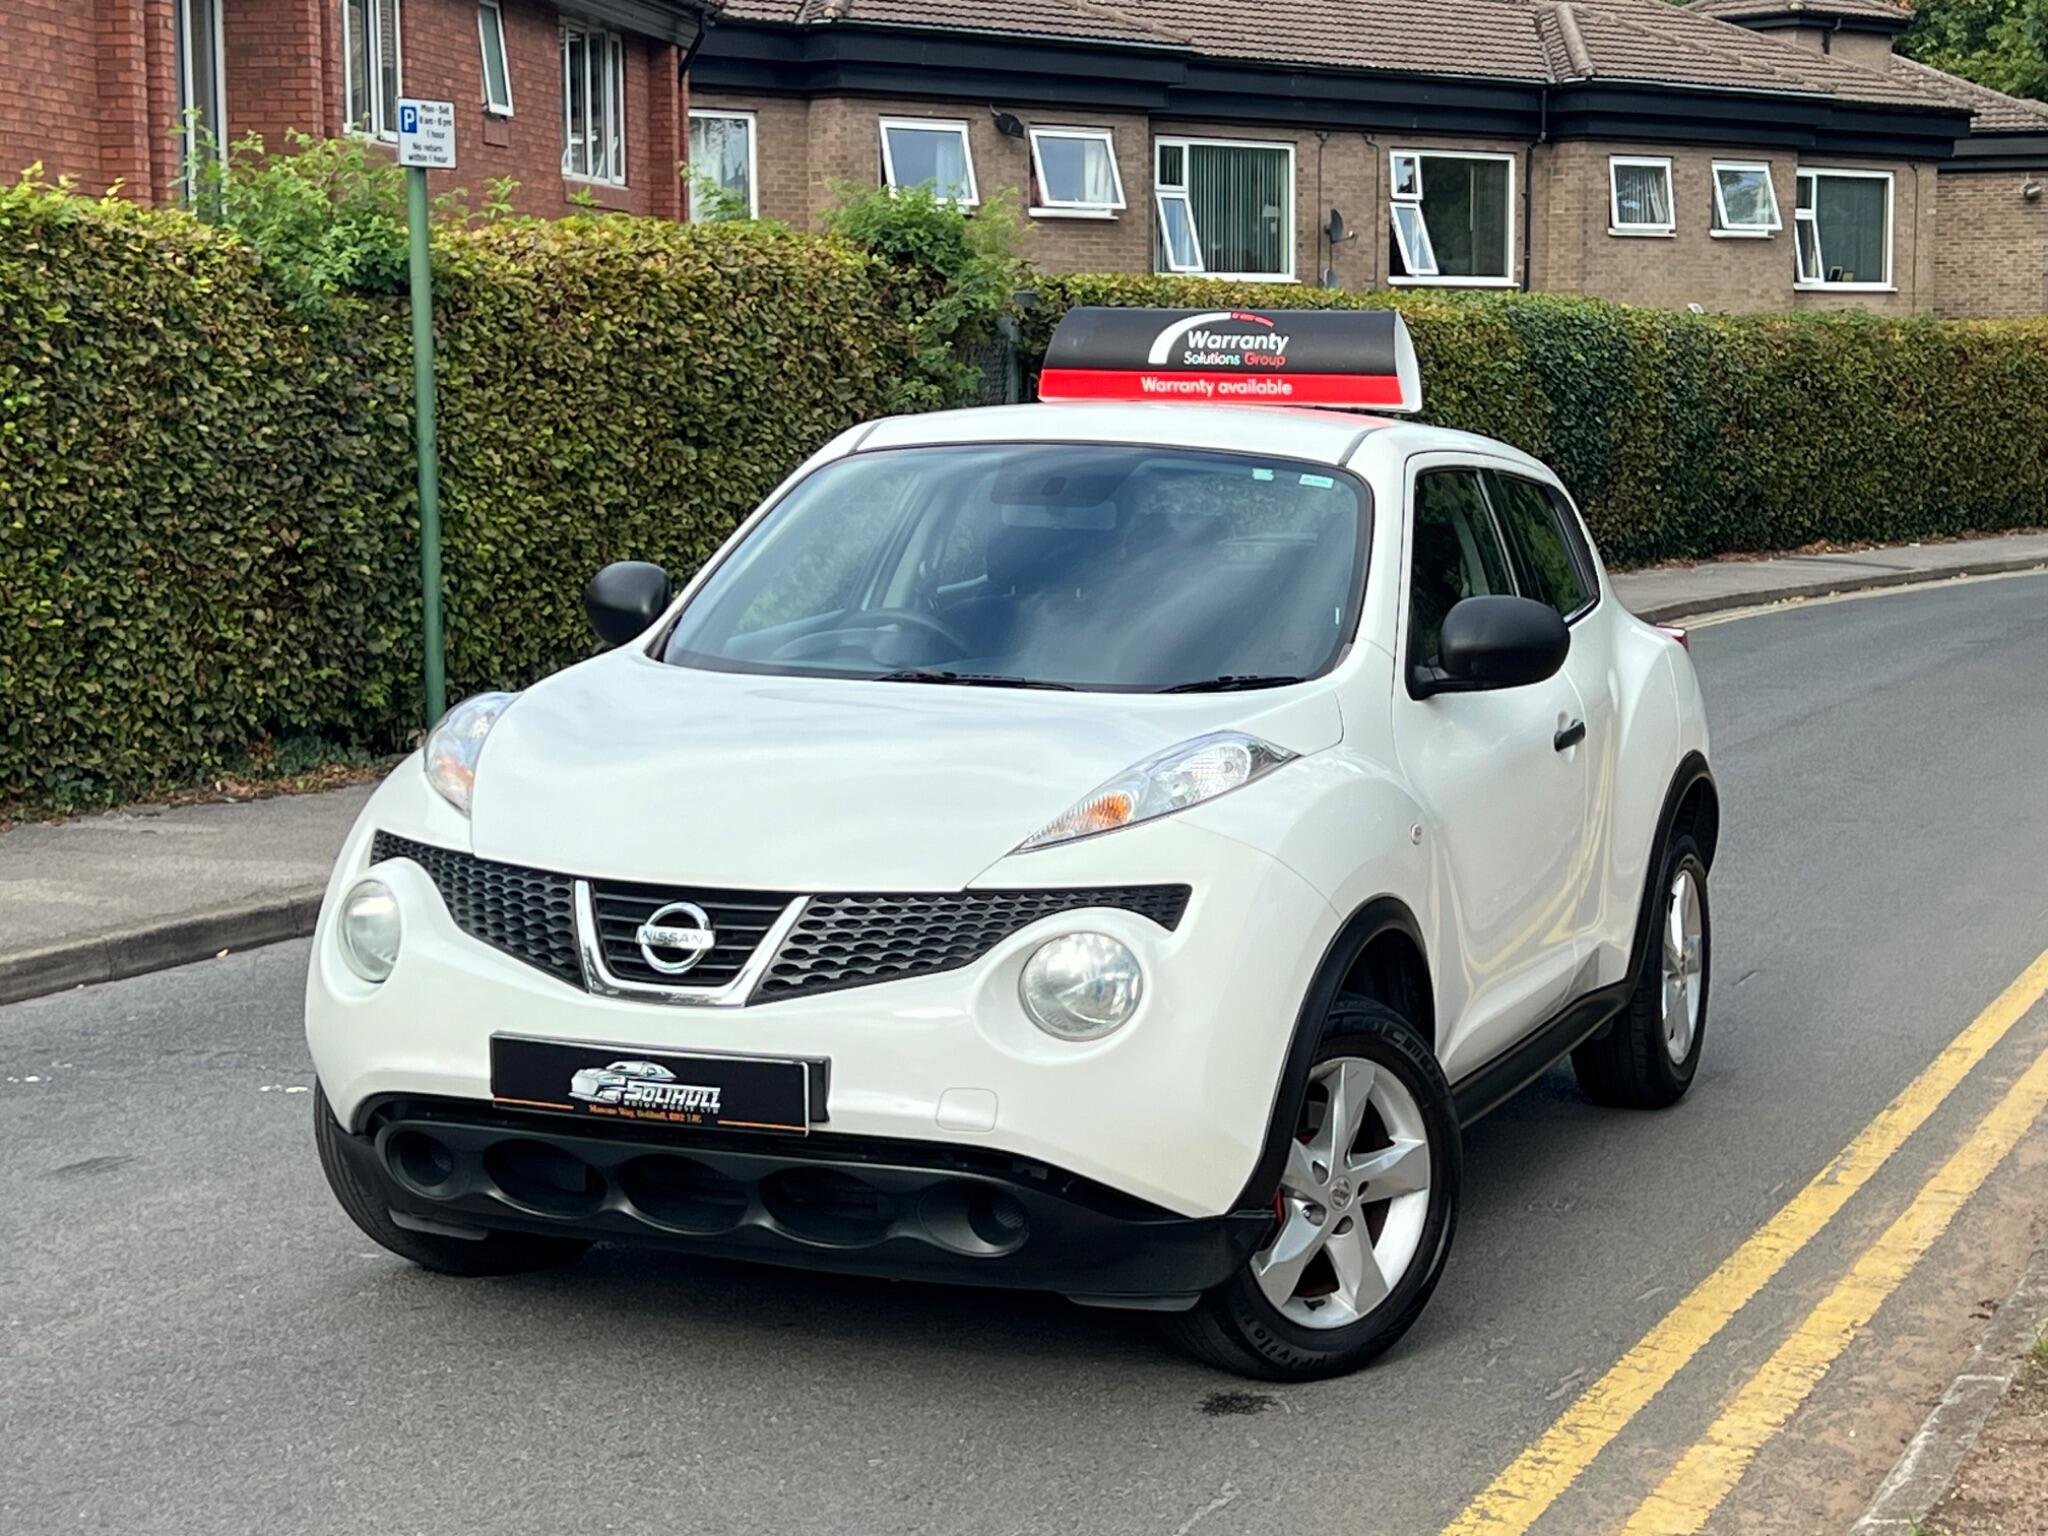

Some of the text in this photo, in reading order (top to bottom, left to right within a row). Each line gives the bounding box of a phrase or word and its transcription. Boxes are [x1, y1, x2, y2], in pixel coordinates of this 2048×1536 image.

[403, 108, 415, 131] P
[432, 131, 445, 139] hour
[412, 142, 443, 152] No return
[433, 155, 448, 163] hour
[1187, 330, 1290, 355] Warranty
[1183, 351, 1287, 369] Solutions Group
[1140, 376, 1293, 398] Warranty available
[642, 929, 704, 943] NISSAN
[623, 1080, 721, 1108] SOLIHULL
